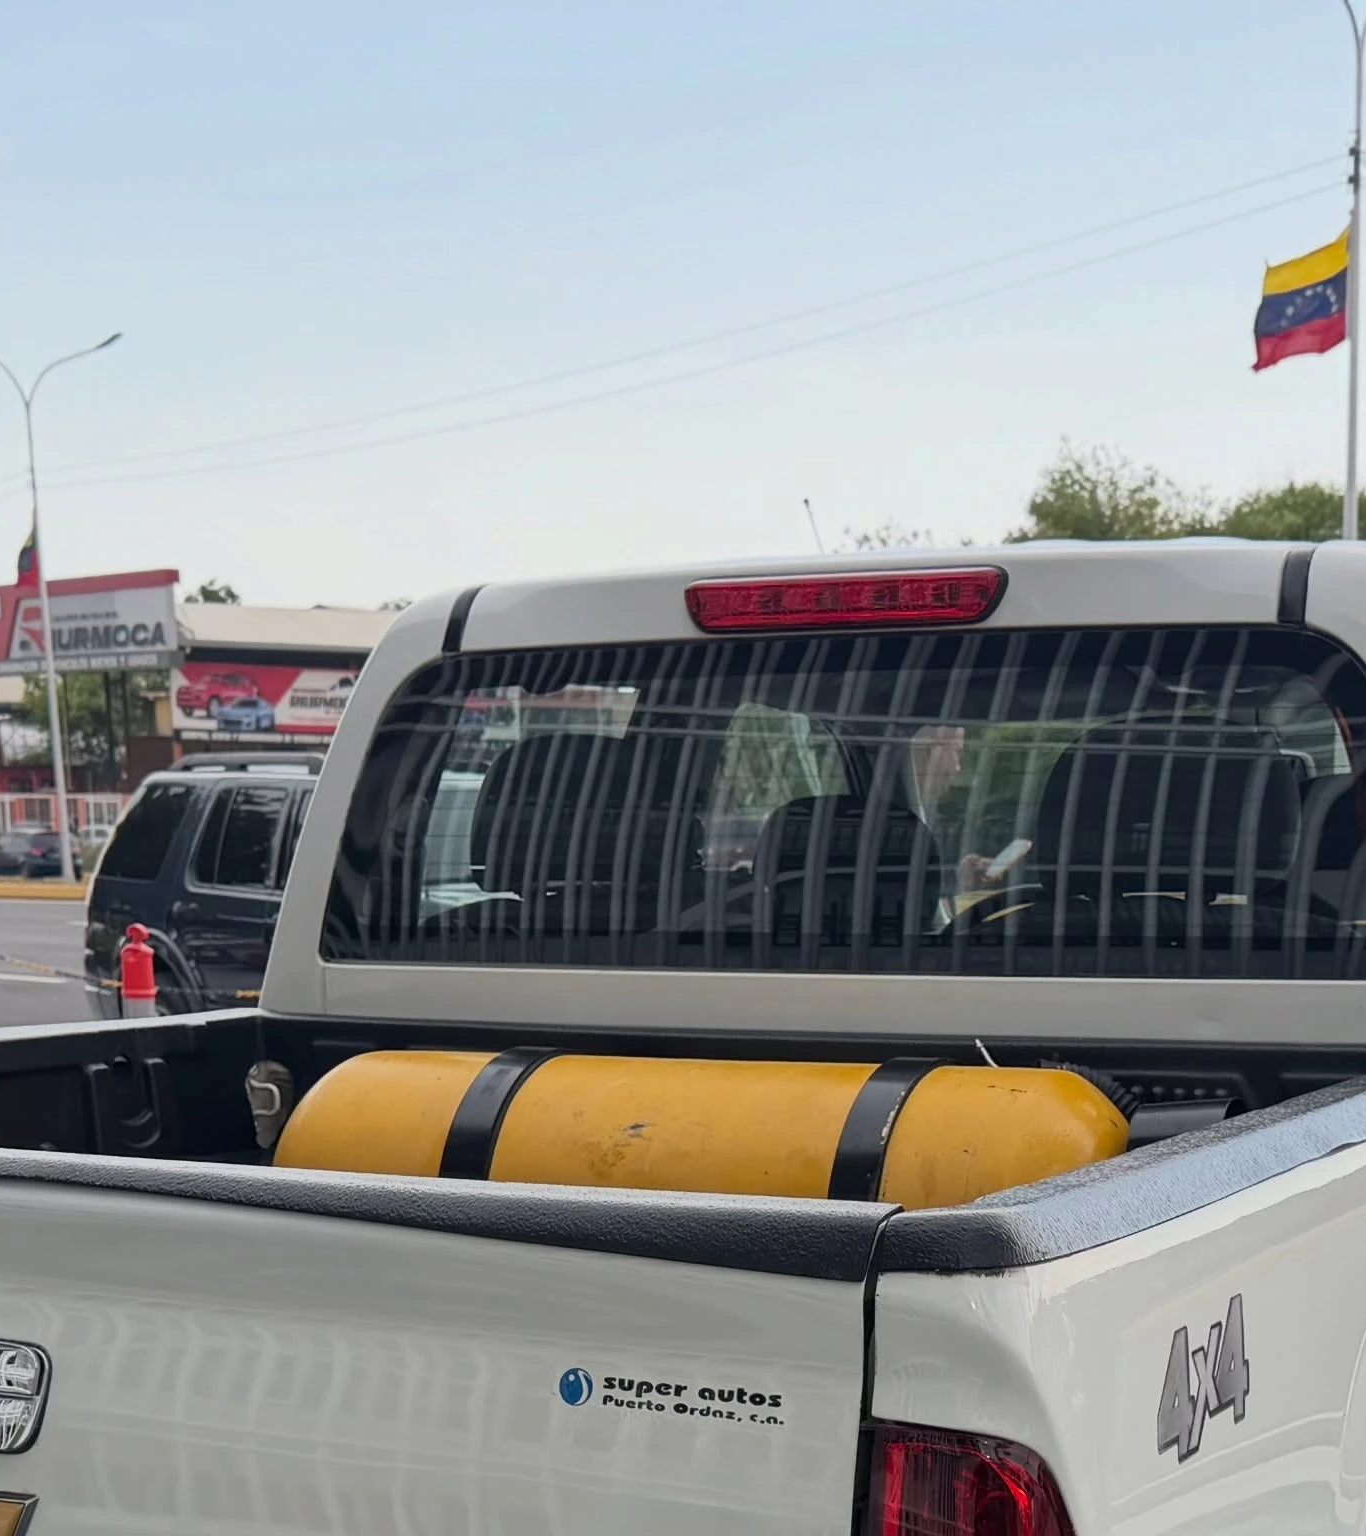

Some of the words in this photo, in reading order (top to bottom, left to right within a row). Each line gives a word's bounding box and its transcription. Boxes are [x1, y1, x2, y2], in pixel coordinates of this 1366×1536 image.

[603, 1376, 687, 1398] super
[698, 1386, 782, 1408] autos
[602, 1394, 666, 1412] Puerto
[673, 1402, 742, 1422] Ordaz,
[749, 1412, 785, 1425] c.a.
